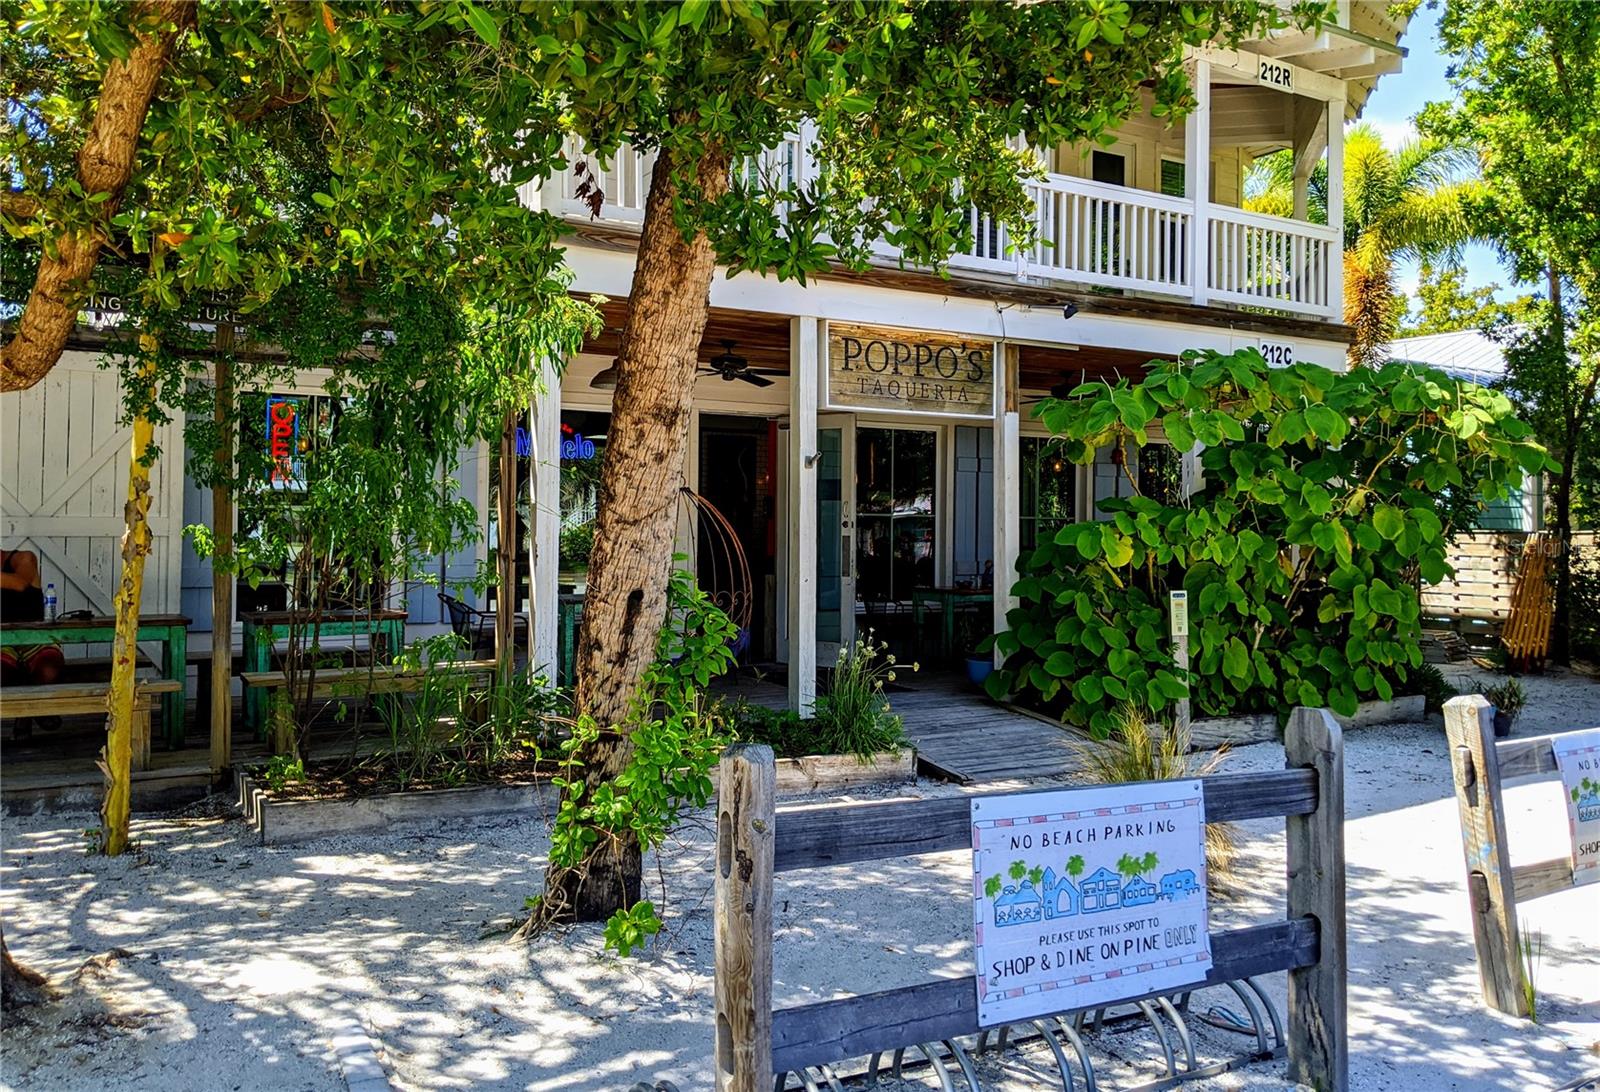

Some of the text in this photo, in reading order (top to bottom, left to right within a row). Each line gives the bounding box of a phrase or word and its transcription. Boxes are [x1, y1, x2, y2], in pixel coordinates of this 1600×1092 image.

[1260, 62, 1291, 87] 212R
[841, 337, 984, 382] POPPO'S
[1261, 344, 1292, 365] 212C
[856, 377, 969, 402] TAQUERIA
[515, 427, 595, 460] Melo
[1577, 758, 1591, 771] NO
[1010, 818, 1177, 851] NO BEACH PARKING
[1039, 916, 1160, 946] PLEASE USE THIS SPOT TO
[992, 923, 1198, 979] SHOP & DINE ON PINE ONLY
